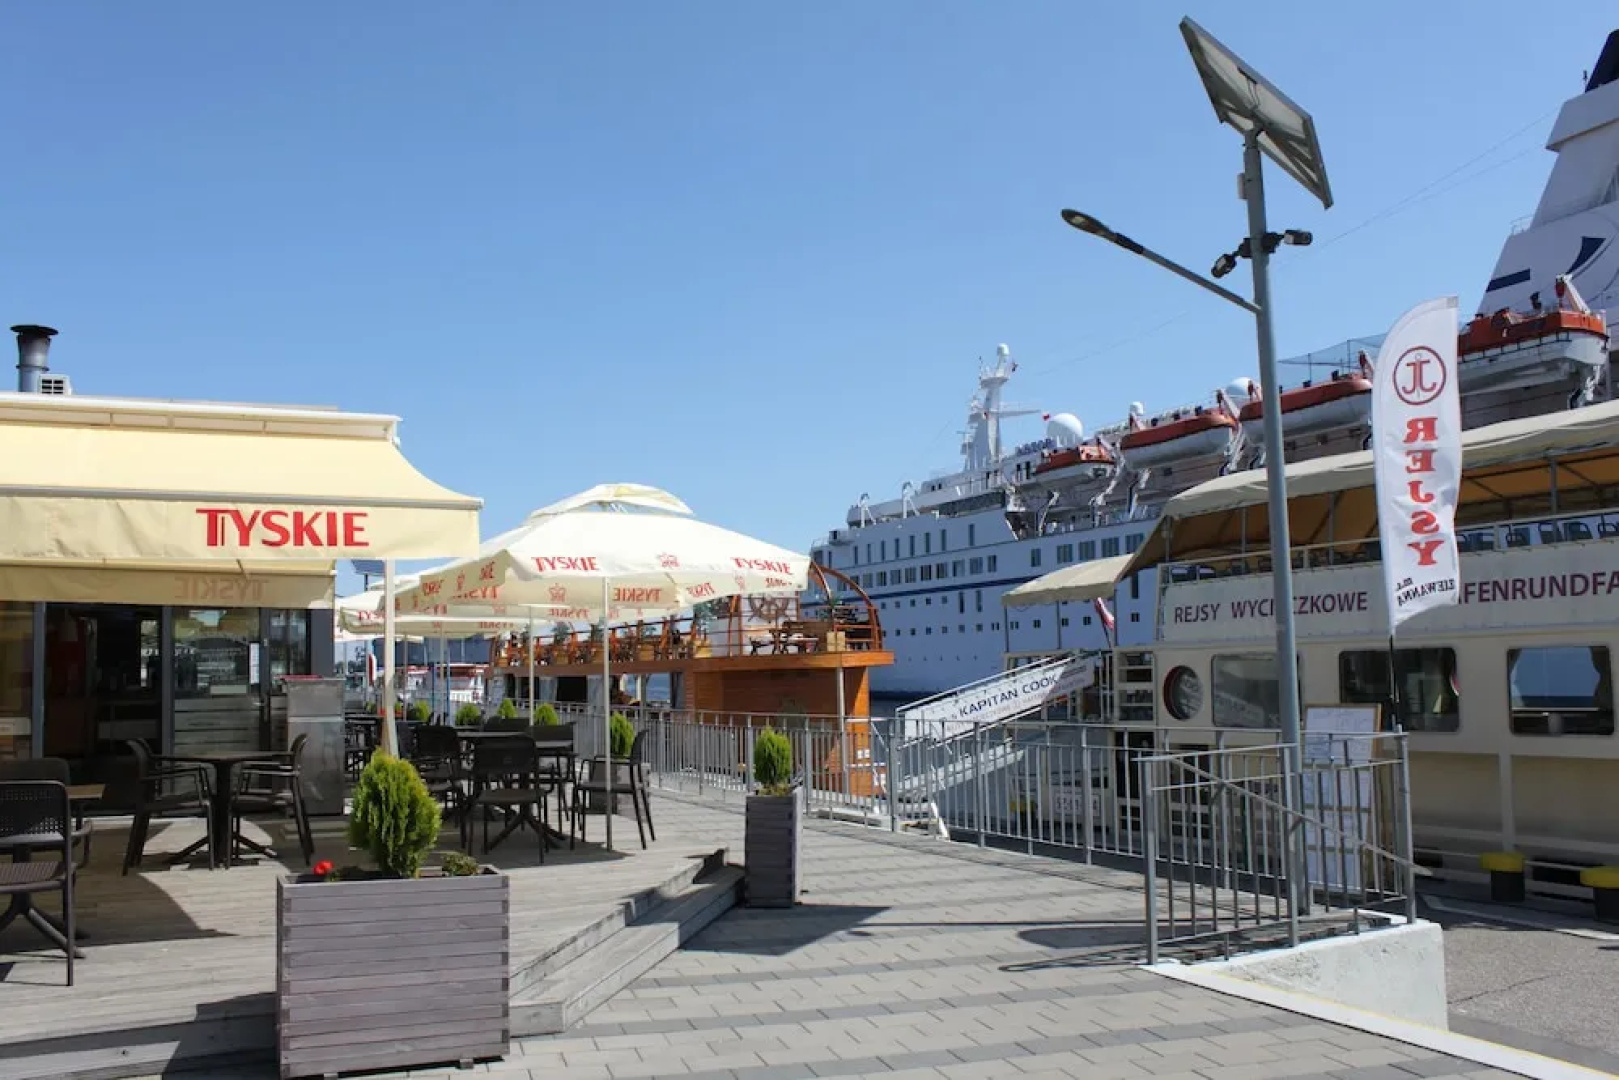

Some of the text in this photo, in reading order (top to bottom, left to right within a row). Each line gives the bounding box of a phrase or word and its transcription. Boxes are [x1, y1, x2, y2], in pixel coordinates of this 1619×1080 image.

[196, 508, 369, 547] TYSKIE
[531, 556, 599, 571] TYSKIE
[731, 557, 793, 575] TYSKIE
[1174, 571, 1619, 624] REJSY WYCIZKOWE FENRUNDFA
[959, 688, 1018, 718] KAPITAN
[1022, 674, 1059, 694] COOK
